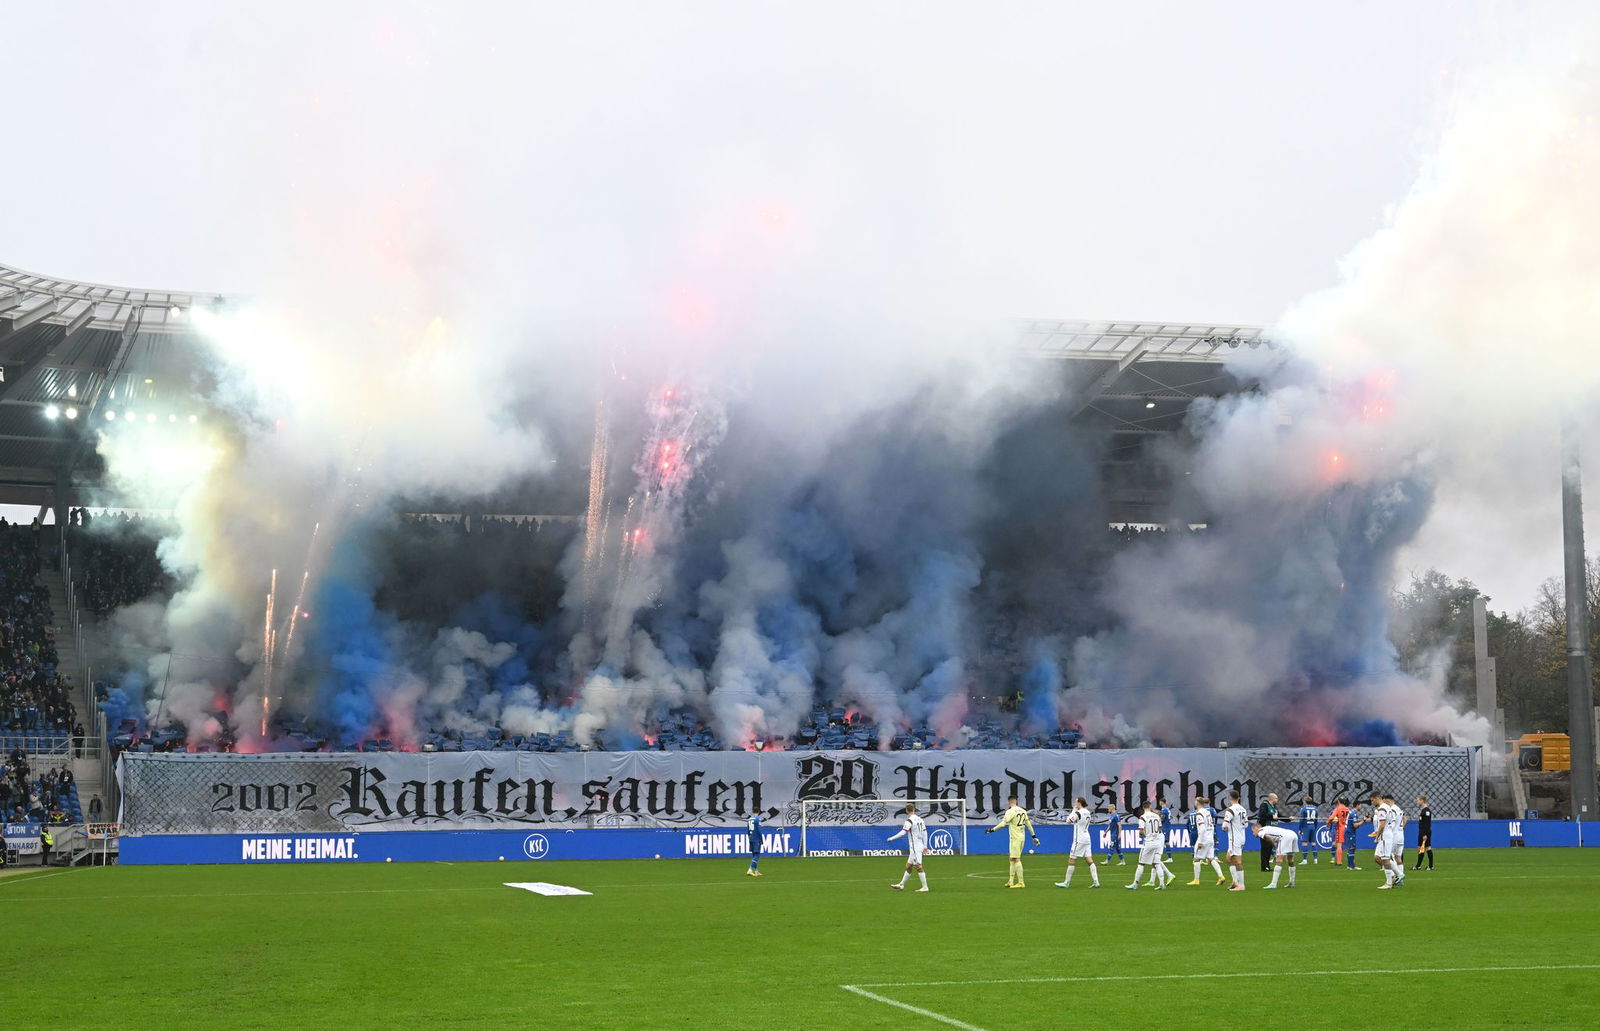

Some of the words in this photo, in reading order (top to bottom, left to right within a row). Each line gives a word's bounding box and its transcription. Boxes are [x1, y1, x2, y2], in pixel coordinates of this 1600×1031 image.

[797, 754, 878, 800] 20
[212, 782, 318, 813] 2002
[893, 763, 1077, 820] Händel
[1091, 770, 1259, 816] suchen
[1285, 778, 1374, 807] 2022
[1306, 809, 1316, 820] 14
[1149, 819, 1159, 834] 10
[242, 839, 291, 860] MEINE
[295, 838, 359, 859] HEIMAT.
[529, 839, 544, 853] KSC
[685, 834, 731, 854] MEINE
[934, 832, 949, 849] KSC
[1100, 830, 1143, 849] MINE
[809, 849, 849, 857] macron
[863, 849, 902, 857] macron
